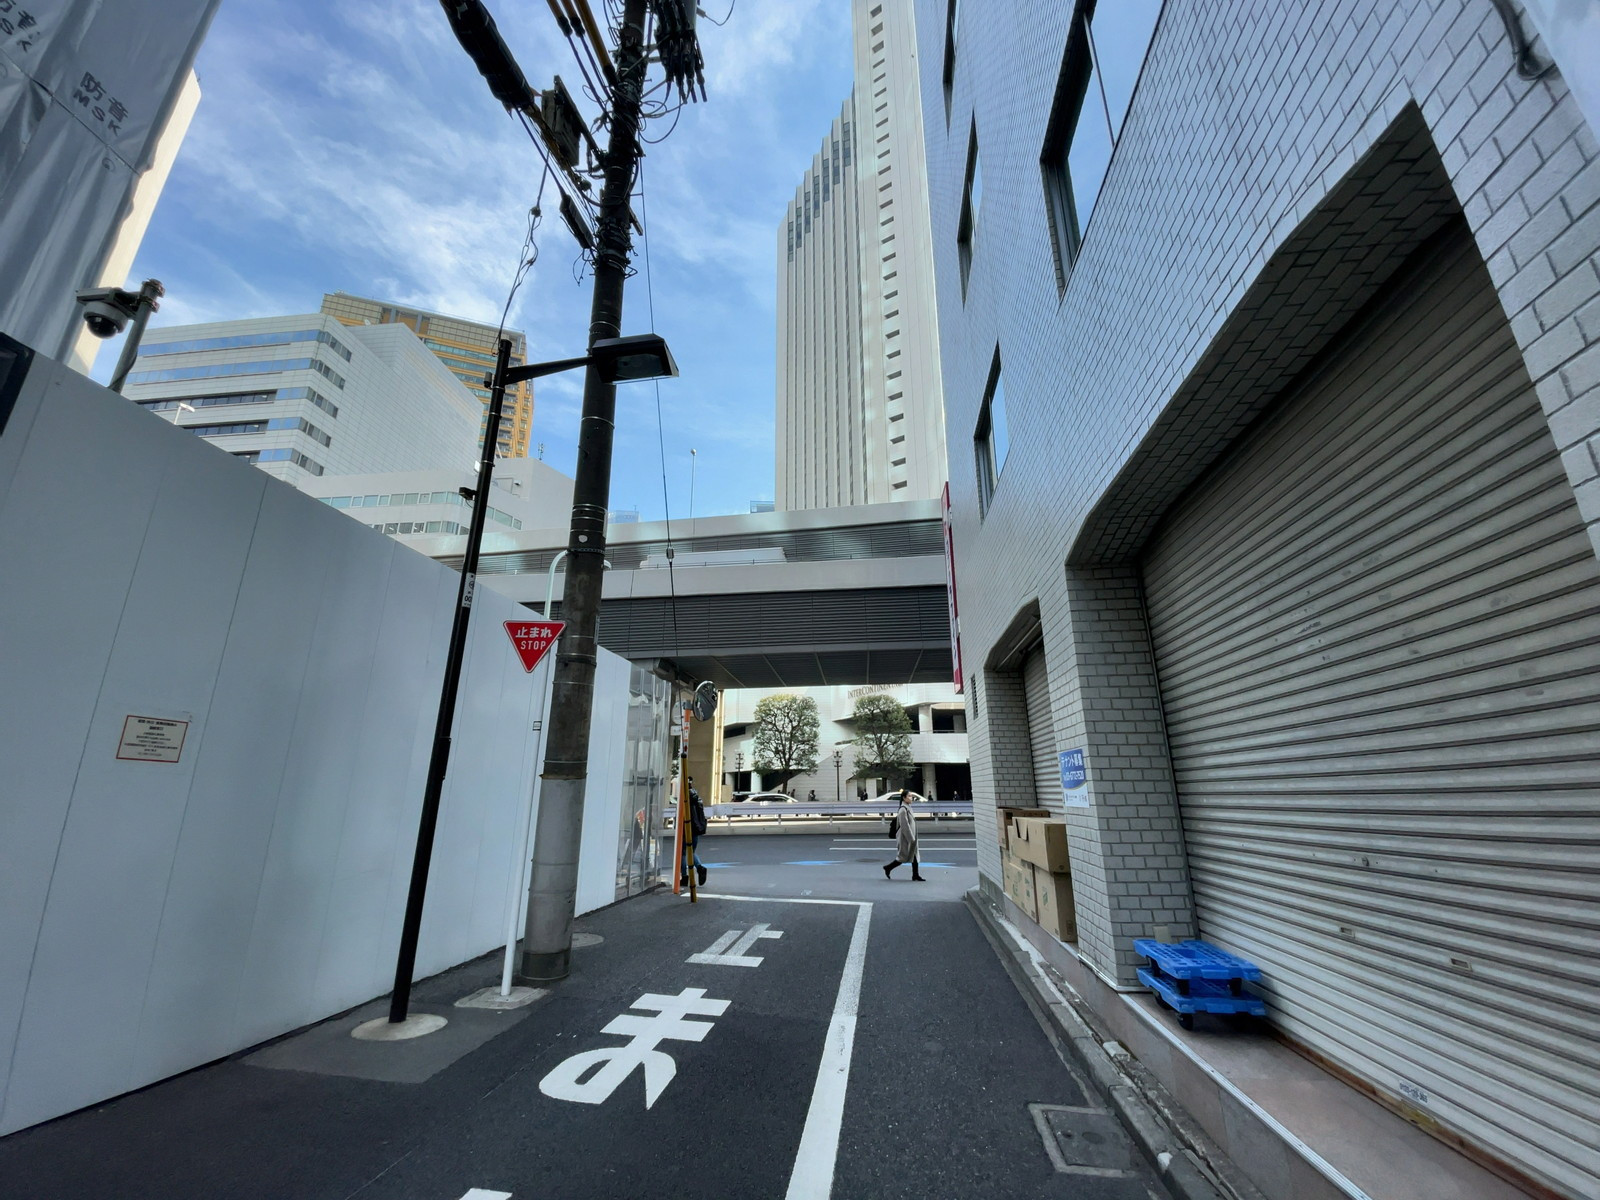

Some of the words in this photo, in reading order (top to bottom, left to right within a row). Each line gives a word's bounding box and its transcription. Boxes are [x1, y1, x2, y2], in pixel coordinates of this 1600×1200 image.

[80, 71, 128, 122] 防音
[73, 89, 121, 136] MSK
[515, 627, 552, 638] 止まれ
[521, 640, 546, 651] STOP
